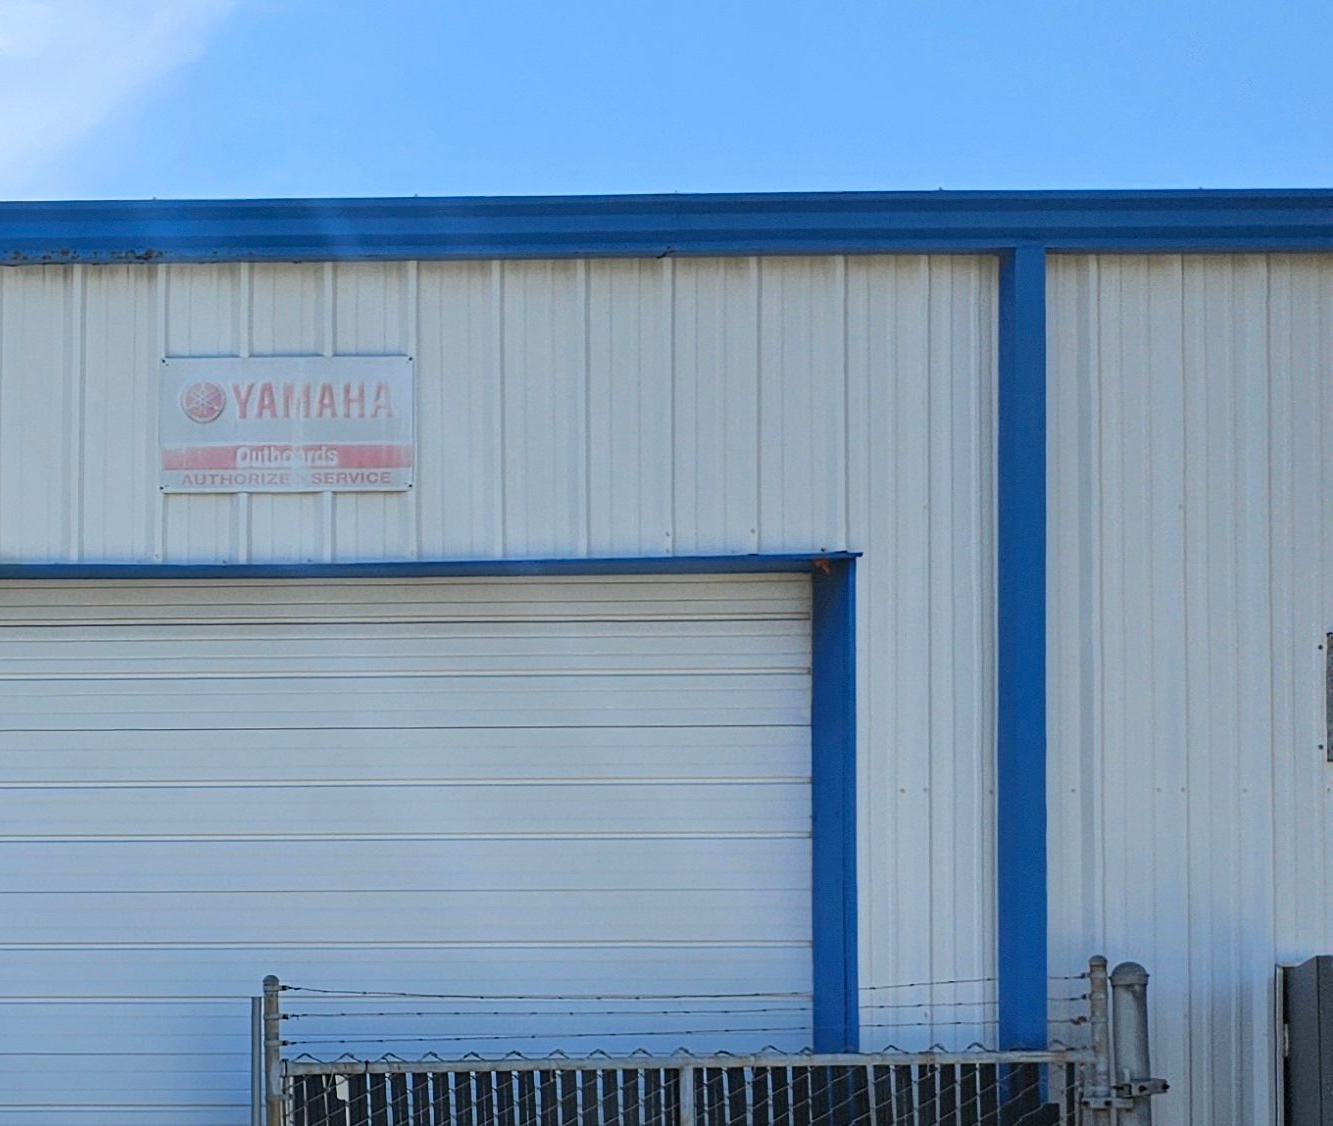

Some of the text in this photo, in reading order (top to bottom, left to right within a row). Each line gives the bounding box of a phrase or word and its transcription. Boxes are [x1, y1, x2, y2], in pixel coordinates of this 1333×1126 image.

[232, 382, 394, 419] YAMAHA
[235, 445, 338, 465] Outbords
[182, 471, 392, 486] AUTHORIZE SERVICE
